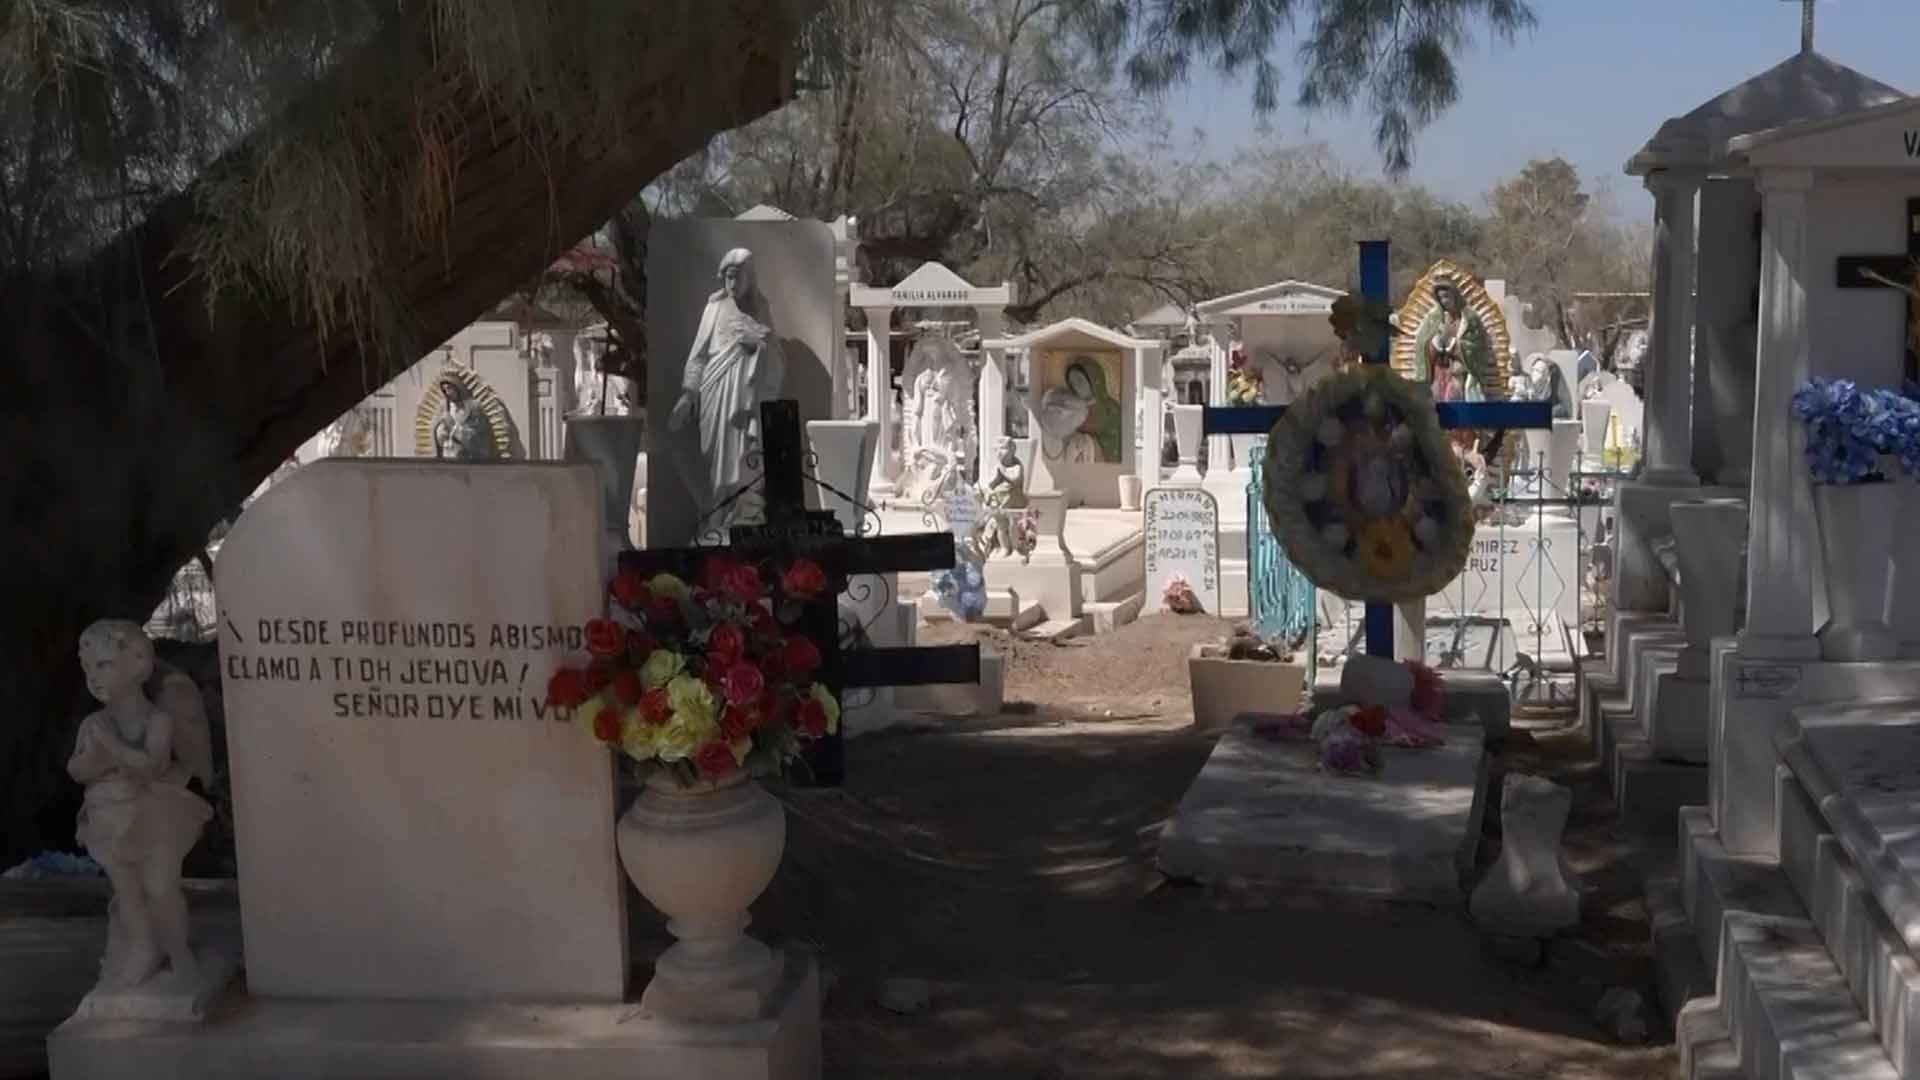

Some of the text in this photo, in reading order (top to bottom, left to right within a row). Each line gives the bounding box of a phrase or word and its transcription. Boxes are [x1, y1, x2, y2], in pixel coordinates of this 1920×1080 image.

[893, 290, 968, 301] FAMILIA ALVARADO
[1464, 558, 1498, 572] RUZ
[257, 618, 332, 645] DESDE
[341, 620, 476, 648] PROFUNDOS
[489, 623, 584, 650] ABISMO
[227, 654, 301, 680] CLAMO
[309, 656, 322, 681] A
[333, 656, 353, 681] TI
[359, 657, 392, 683] OH
[400, 659, 509, 686] JEHOVA
[332, 686, 421, 719] SEÑOR
[427, 693, 484, 719] OYE
[531, 698, 573, 722] VO
